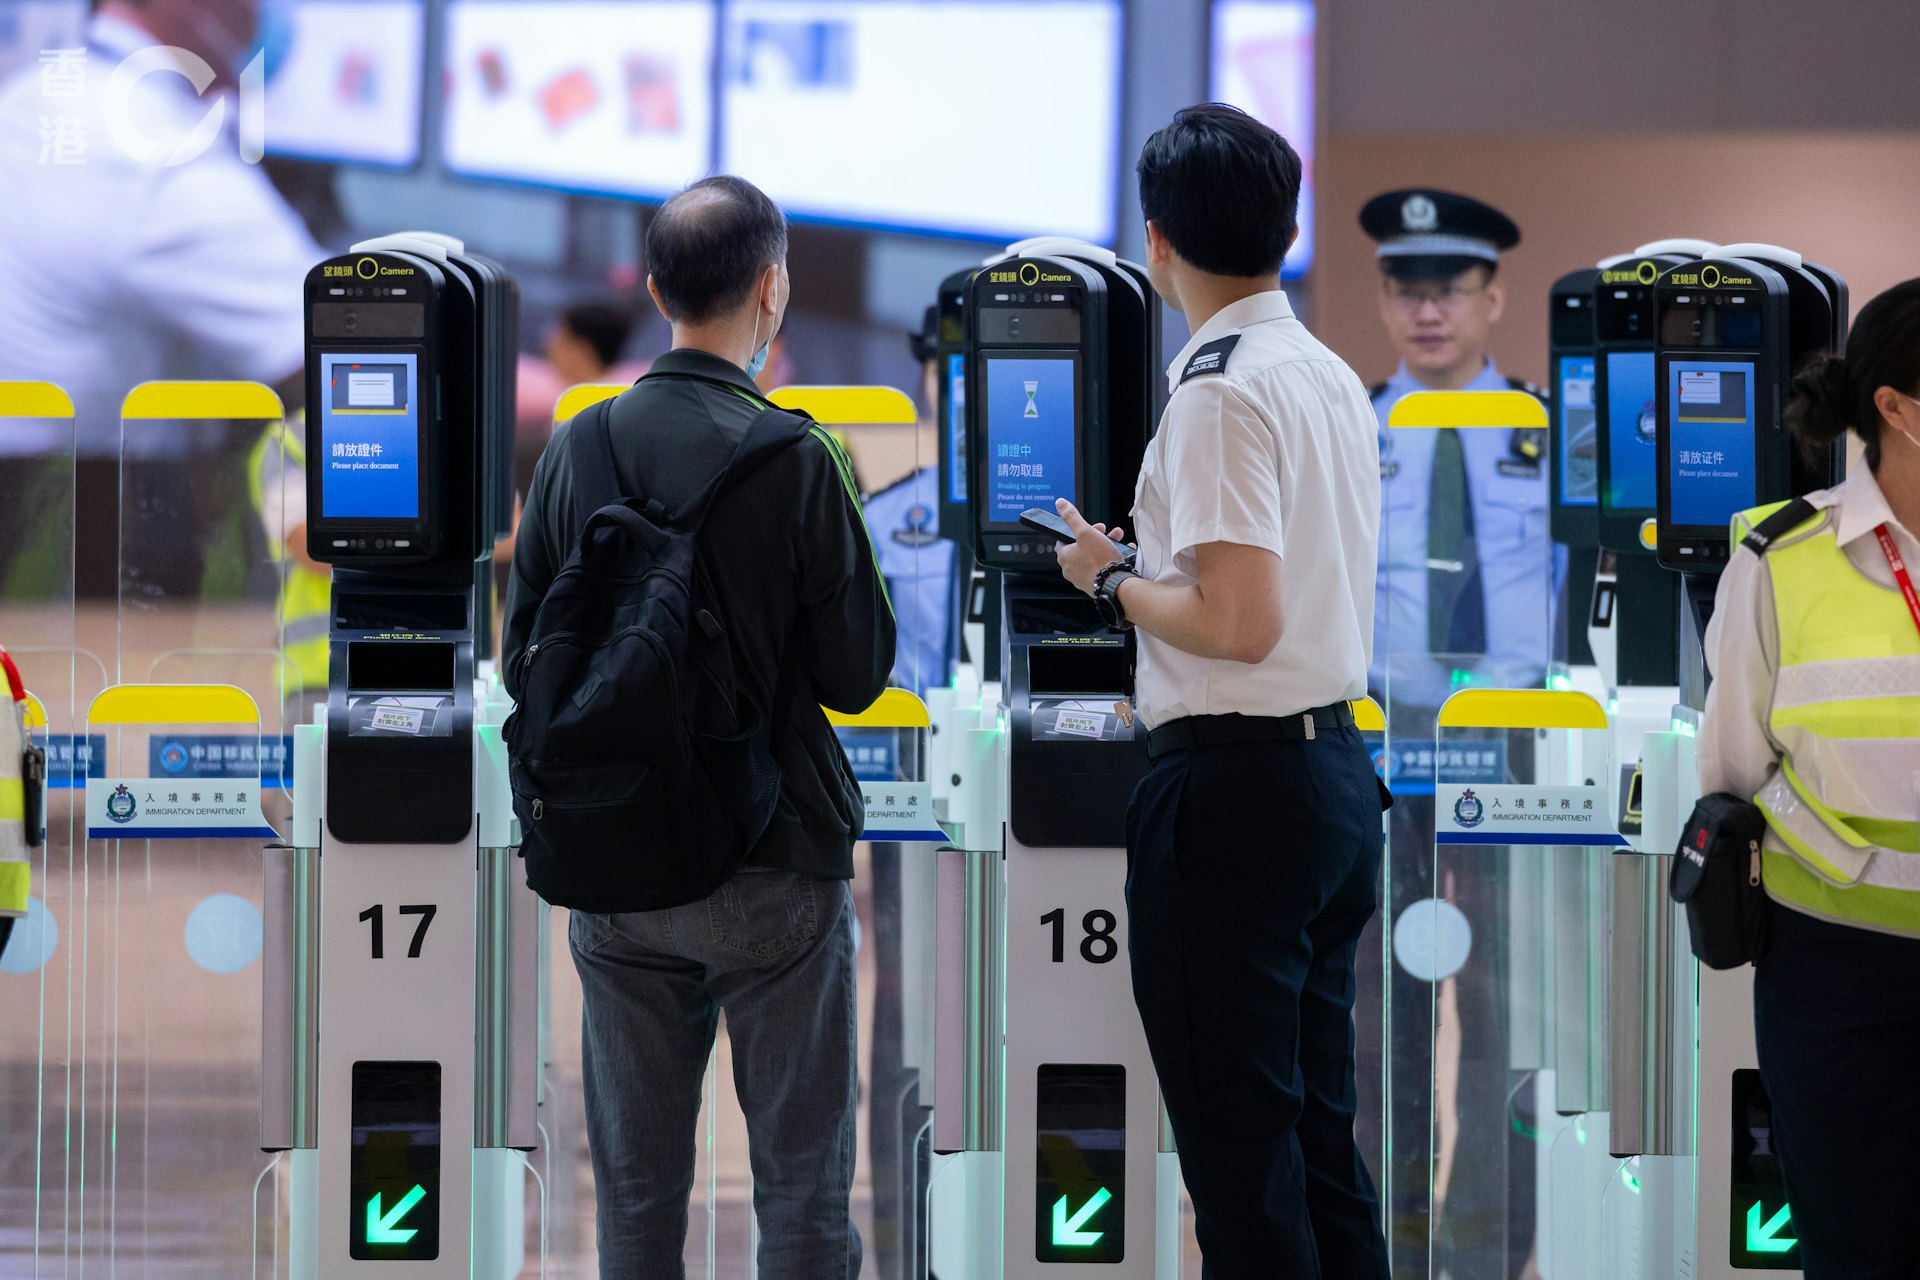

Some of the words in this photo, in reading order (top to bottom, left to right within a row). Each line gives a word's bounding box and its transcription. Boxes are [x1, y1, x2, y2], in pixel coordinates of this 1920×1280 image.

[324, 266, 353, 277] 望鏡頭
[381, 267, 414, 275] Camera
[990, 272, 1017, 283] 望鏡頭
[1041, 273, 1071, 282] Camera
[1672, 274, 1698, 285] 望鏡頭
[1722, 276, 1752, 284] Camera
[332, 443, 383, 457] 請放證件
[997, 444, 1031, 458] 讀證中
[1679, 450, 1724, 465] 请放证件
[352, 462, 368, 471] place
[997, 463, 1044, 477] 請勿取證
[1679, 469, 1696, 477] Please
[1697, 470, 1711, 478] place
[1712, 470, 1739, 478] document
[145, 792, 247, 803] 入境事務處
[1492, 798, 1593, 809] 入境事務處
[1542, 814, 1592, 822] DEPARTMENT
[359, 904, 438, 959] 17
[1040, 908, 1118, 964] 18
